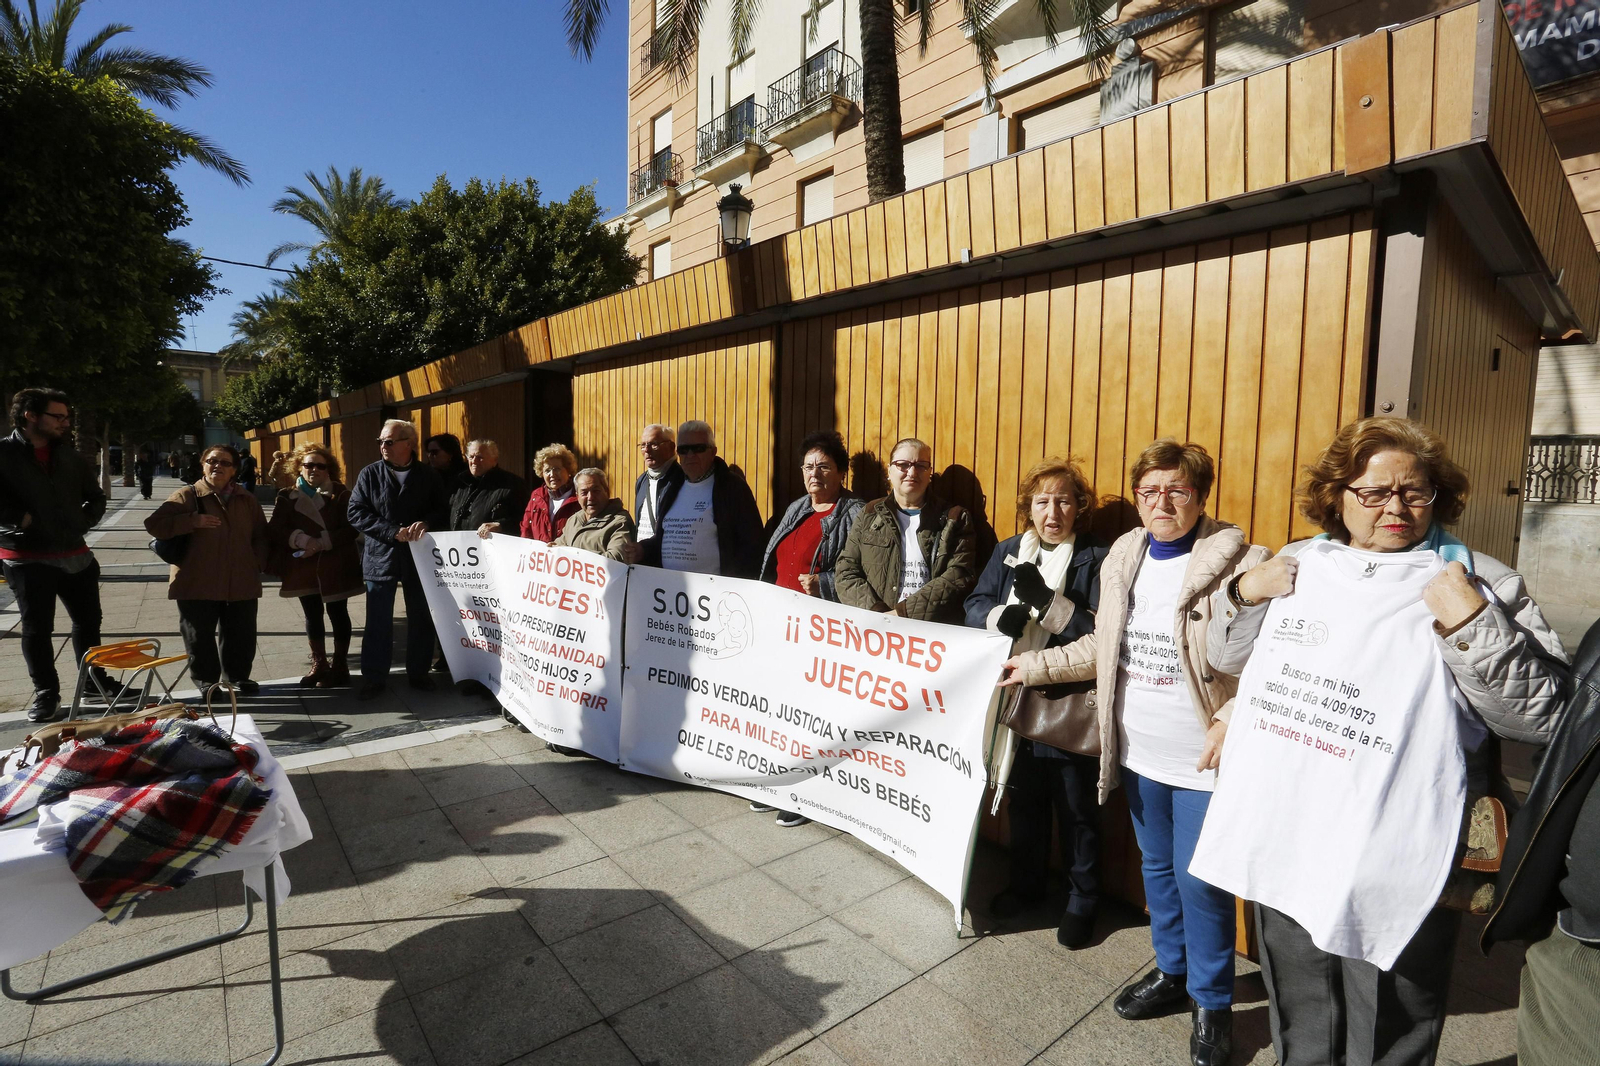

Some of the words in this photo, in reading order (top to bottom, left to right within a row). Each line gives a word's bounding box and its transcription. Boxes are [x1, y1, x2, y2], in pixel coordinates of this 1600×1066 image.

[1514, 10, 1600, 51] MAM
[431, 546, 480, 568] S.O.S
[454, 570, 486, 580] Robados
[528, 550, 607, 588] SEÑORES
[464, 581, 489, 590] Frontera
[522, 581, 590, 615] JUECES
[653, 588, 711, 622] S.O.S
[459, 608, 482, 622] SON
[527, 636, 606, 669] HUMANIDAD
[507, 610, 521, 625] NO
[520, 613, 587, 644] PRESCRIBEN
[645, 632, 666, 645] Jerez
[667, 636, 677, 647] de
[678, 637, 685, 649] la
[687, 641, 718, 656] Frontera
[647, 617, 675, 632] Bebés
[677, 622, 716, 641] Robados
[809, 614, 946, 673] SEÑORES
[1134, 630, 1150, 641] hijos
[1156, 632, 1170, 644] niño
[460, 637, 506, 660] QUEREMOS
[536, 679, 556, 697] DE
[559, 685, 608, 712] MORIR
[478, 625, 503, 643] DONDE
[541, 662, 579, 684] HIJOS
[583, 672, 592, 687] ?
[1146, 660, 1164, 672] Jerez
[1165, 663, 1175, 674] de
[804, 656, 909, 711] JUECES
[920, 688, 946, 714] !!
[1153, 676, 1174, 687] busca
[1281, 663, 1312, 683] Busco
[1313, 675, 1321, 686] a
[1322, 678, 1338, 691] mi
[1339, 680, 1361, 699] hijo
[1265, 680, 1289, 696] nacido
[1290, 687, 1302, 700] el
[1302, 690, 1319, 706] día
[1321, 696, 1376, 725] 4/09/1973
[648, 667, 709, 695] PEDIMOS
[712, 682, 772, 718] VERDAD,
[776, 703, 834, 741] JUSTICIA
[837, 725, 848, 742] Y
[853, 728, 972, 780] REPARACIÓN
[701, 706, 741, 734] PARA
[745, 721, 788, 752] MILES
[791, 739, 815, 760] DE
[817, 747, 907, 778] MADRES
[1259, 717, 1267, 730] tu
[1269, 722, 1301, 742] madre
[1303, 732, 1313, 746] te
[1315, 736, 1347, 759] busca
[1348, 749, 1356, 761] !
[1260, 696, 1294, 718] hospital
[1294, 708, 1307, 723] de
[1308, 713, 1340, 734] Jerez
[1341, 725, 1357, 740] de
[1358, 730, 1370, 746] la
[1372, 736, 1395, 755] Fra.
[677, 728, 705, 752] QUE
[707, 739, 734, 762] LES
[822, 765, 834, 782] A
[837, 771, 871, 796] SUS
[876, 782, 932, 824] BEBÉS
[799, 796, 917, 859] sosbebesrobadosjerez@gmail.com
